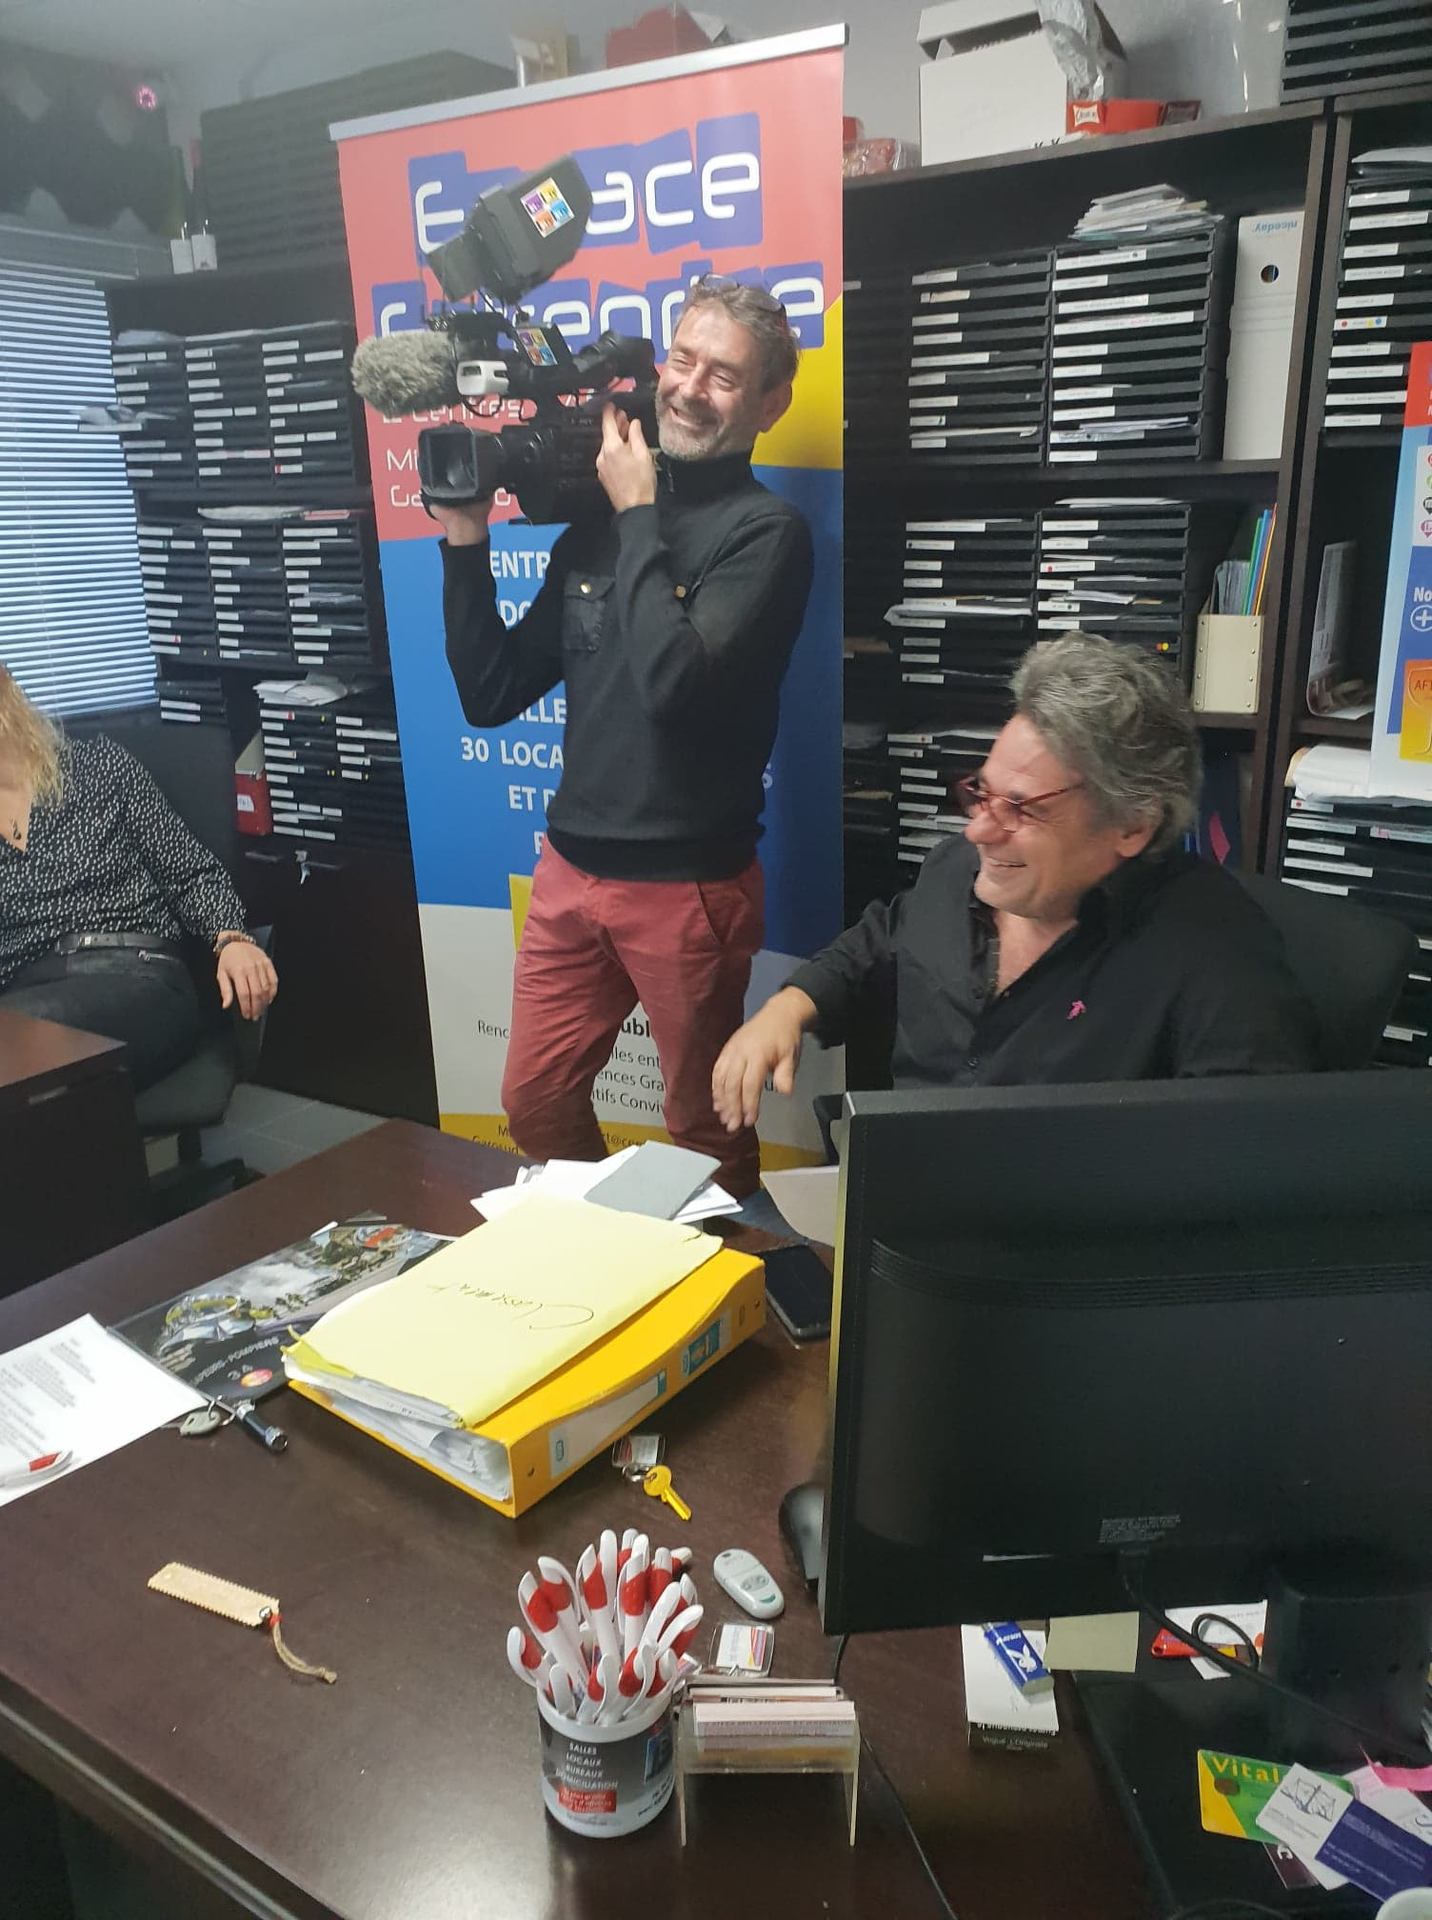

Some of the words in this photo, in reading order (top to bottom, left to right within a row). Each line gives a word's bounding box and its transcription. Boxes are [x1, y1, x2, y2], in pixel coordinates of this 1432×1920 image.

[415, 151, 760, 255] Eace
[461, 736, 489, 762] 30
[508, 784, 536, 811] ET
[569, 1742, 597, 1755] SALLES
[566, 1752, 602, 1767] LOCAUX
[565, 1764, 604, 1779] BUREAUX
